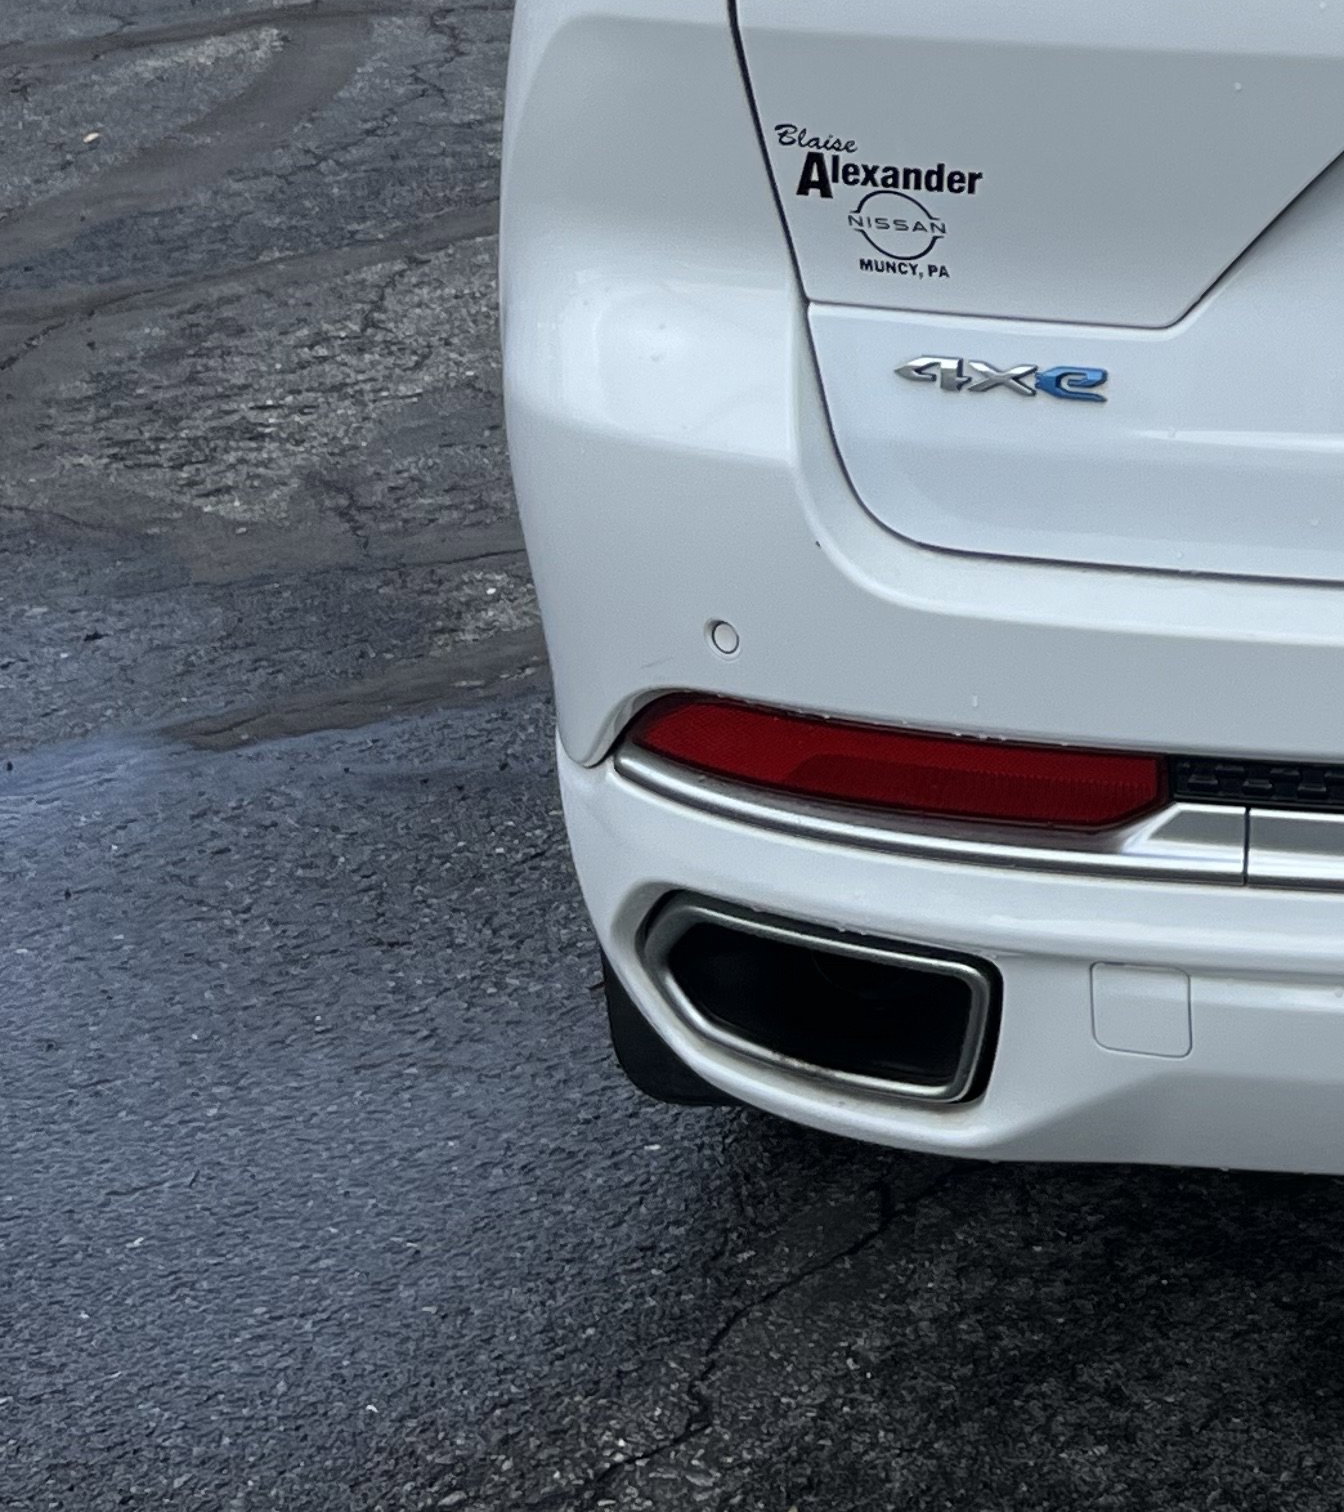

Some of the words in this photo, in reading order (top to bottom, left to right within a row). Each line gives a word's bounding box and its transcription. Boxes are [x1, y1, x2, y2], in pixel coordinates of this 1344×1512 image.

[773, 123, 858, 154] Blaise
[796, 150, 983, 199] Alexander
[847, 213, 947, 235] NISSAN
[859, 258, 924, 279] MUNCY,
[927, 263, 950, 279] PA
